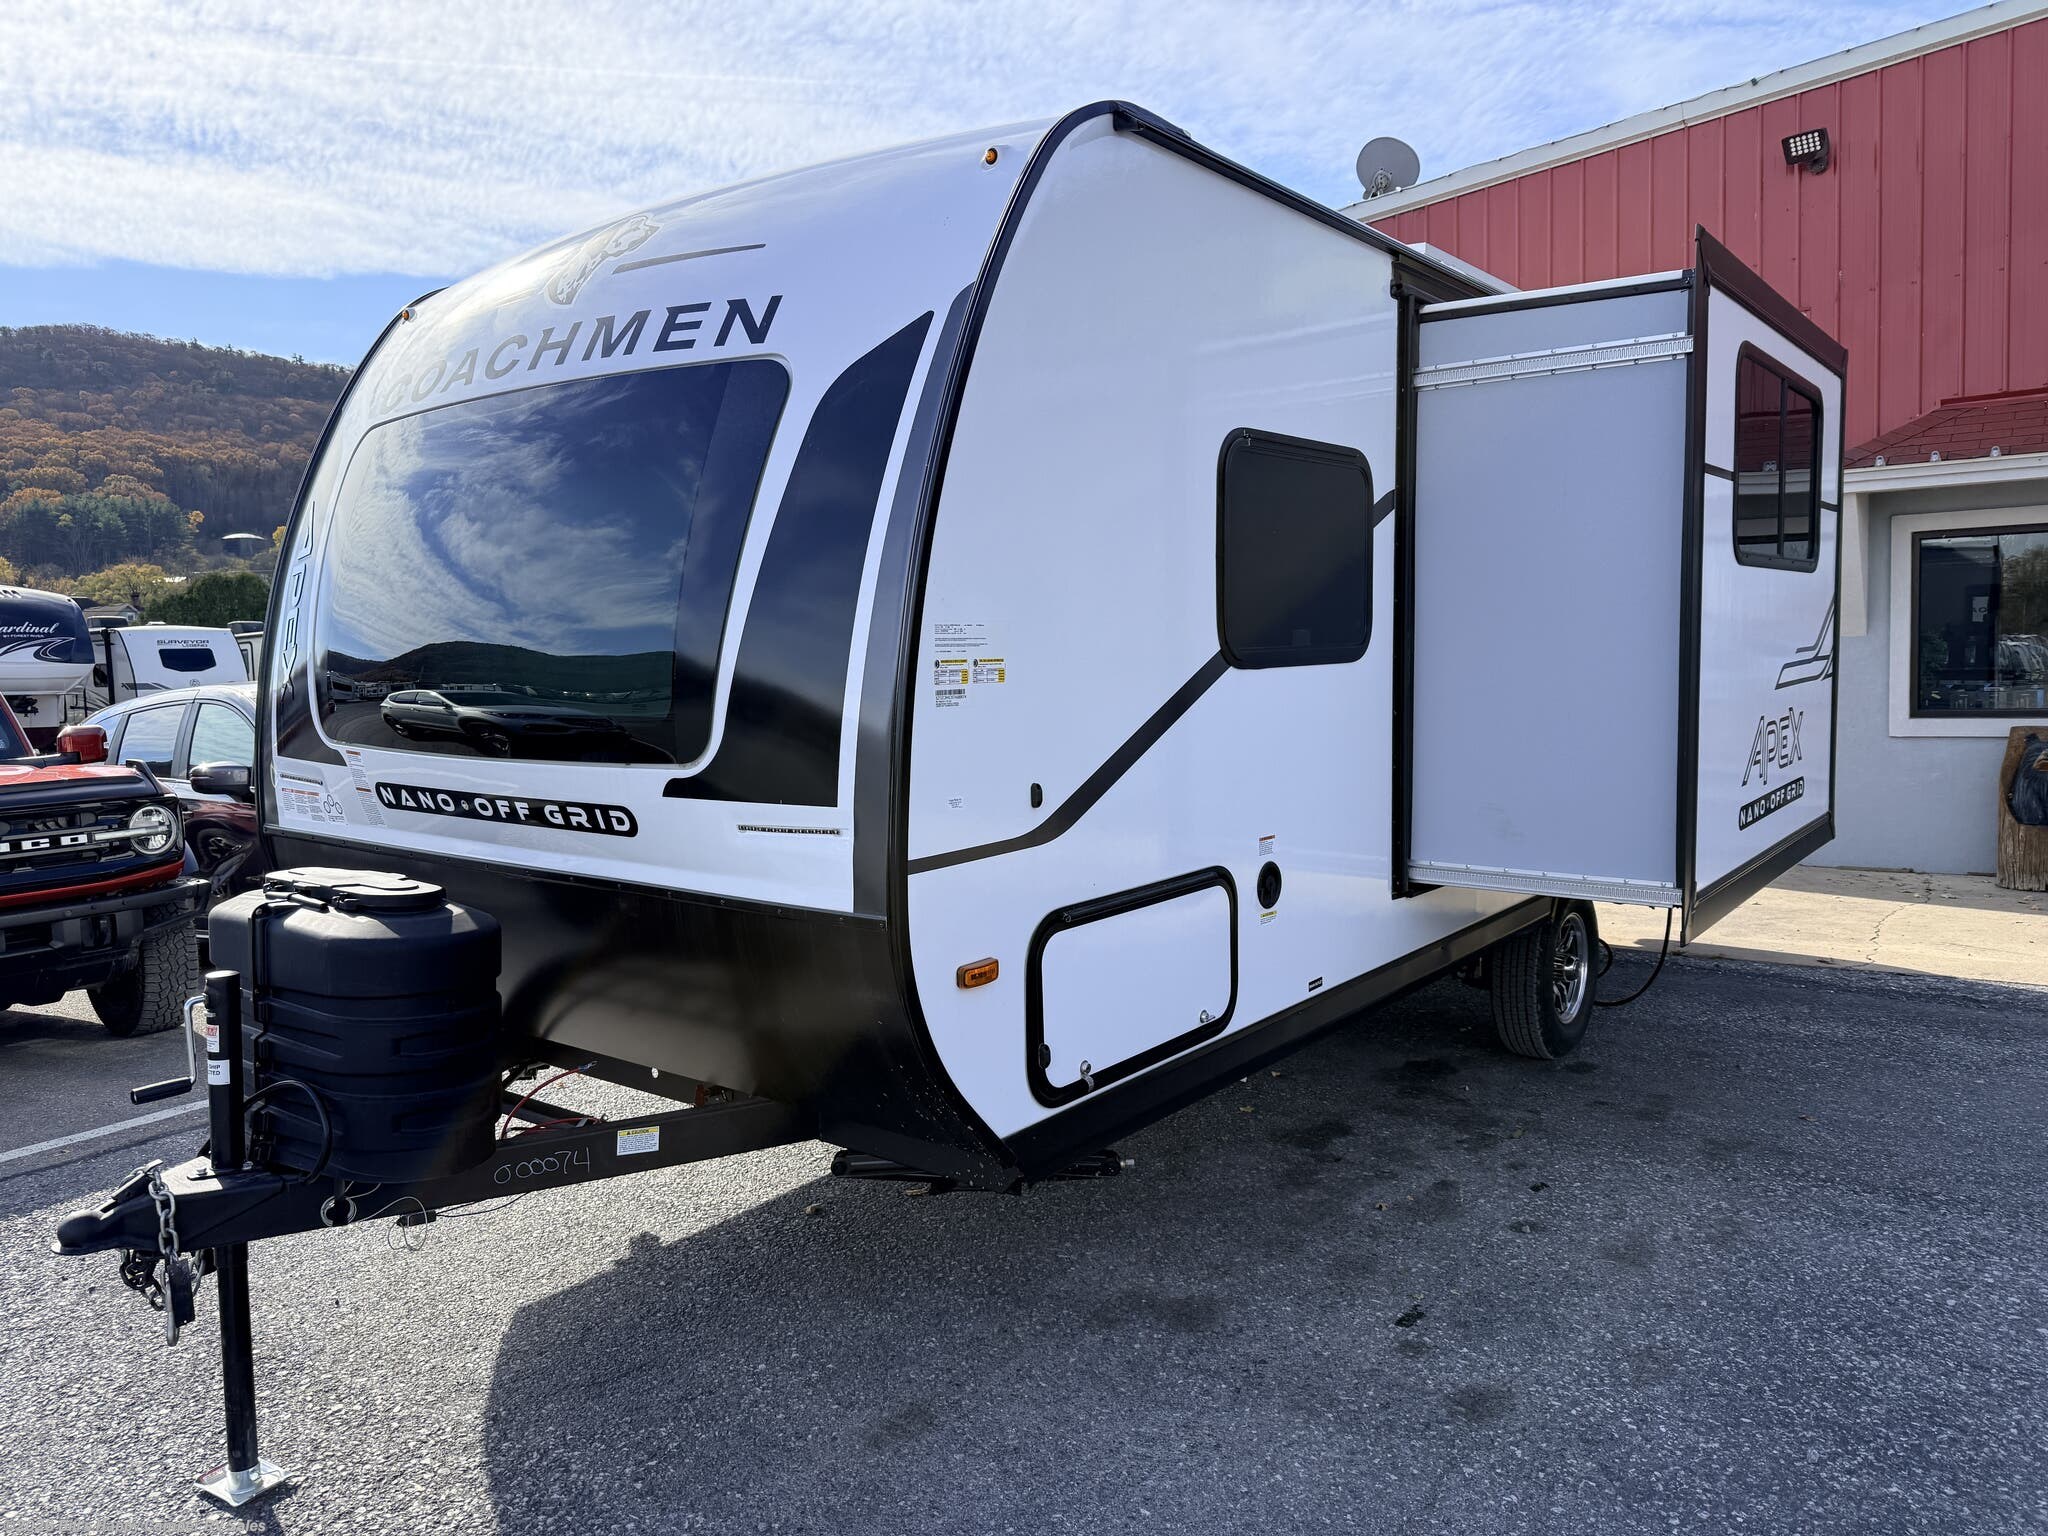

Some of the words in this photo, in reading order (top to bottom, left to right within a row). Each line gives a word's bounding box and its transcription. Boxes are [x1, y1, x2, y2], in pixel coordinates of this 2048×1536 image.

[380, 295, 784, 415] COACHMEN
[0, 621, 60, 635] ardinal
[281, 500, 316, 702] APEX
[1741, 706, 1804, 787] APEX
[379, 785, 455, 812] NANO
[474, 797, 530, 821] OFF
[544, 805, 631, 833] GRID
[1740, 799, 1766, 827] NANO
[1770, 790, 1785, 810] OFF
[1787, 779, 1804, 800] GRID
